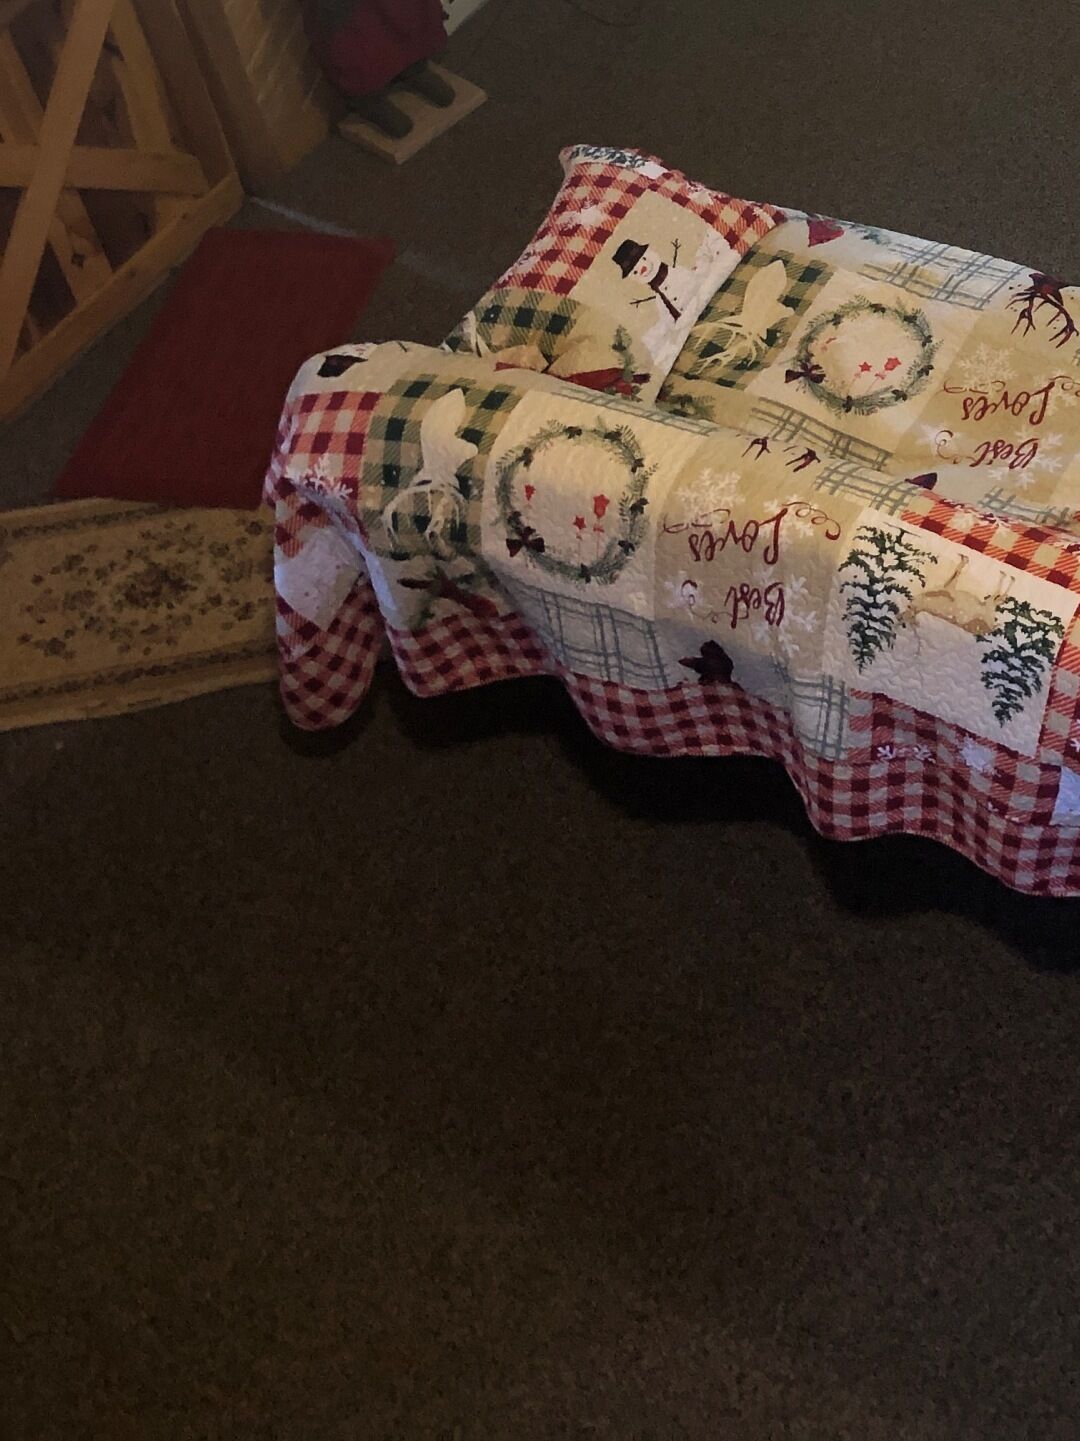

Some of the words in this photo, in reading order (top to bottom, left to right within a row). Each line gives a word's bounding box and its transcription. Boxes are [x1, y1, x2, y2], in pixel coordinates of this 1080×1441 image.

[969, 436, 1041, 470] Best
[688, 501, 842, 565] Loves
[724, 580, 788, 629] Best
